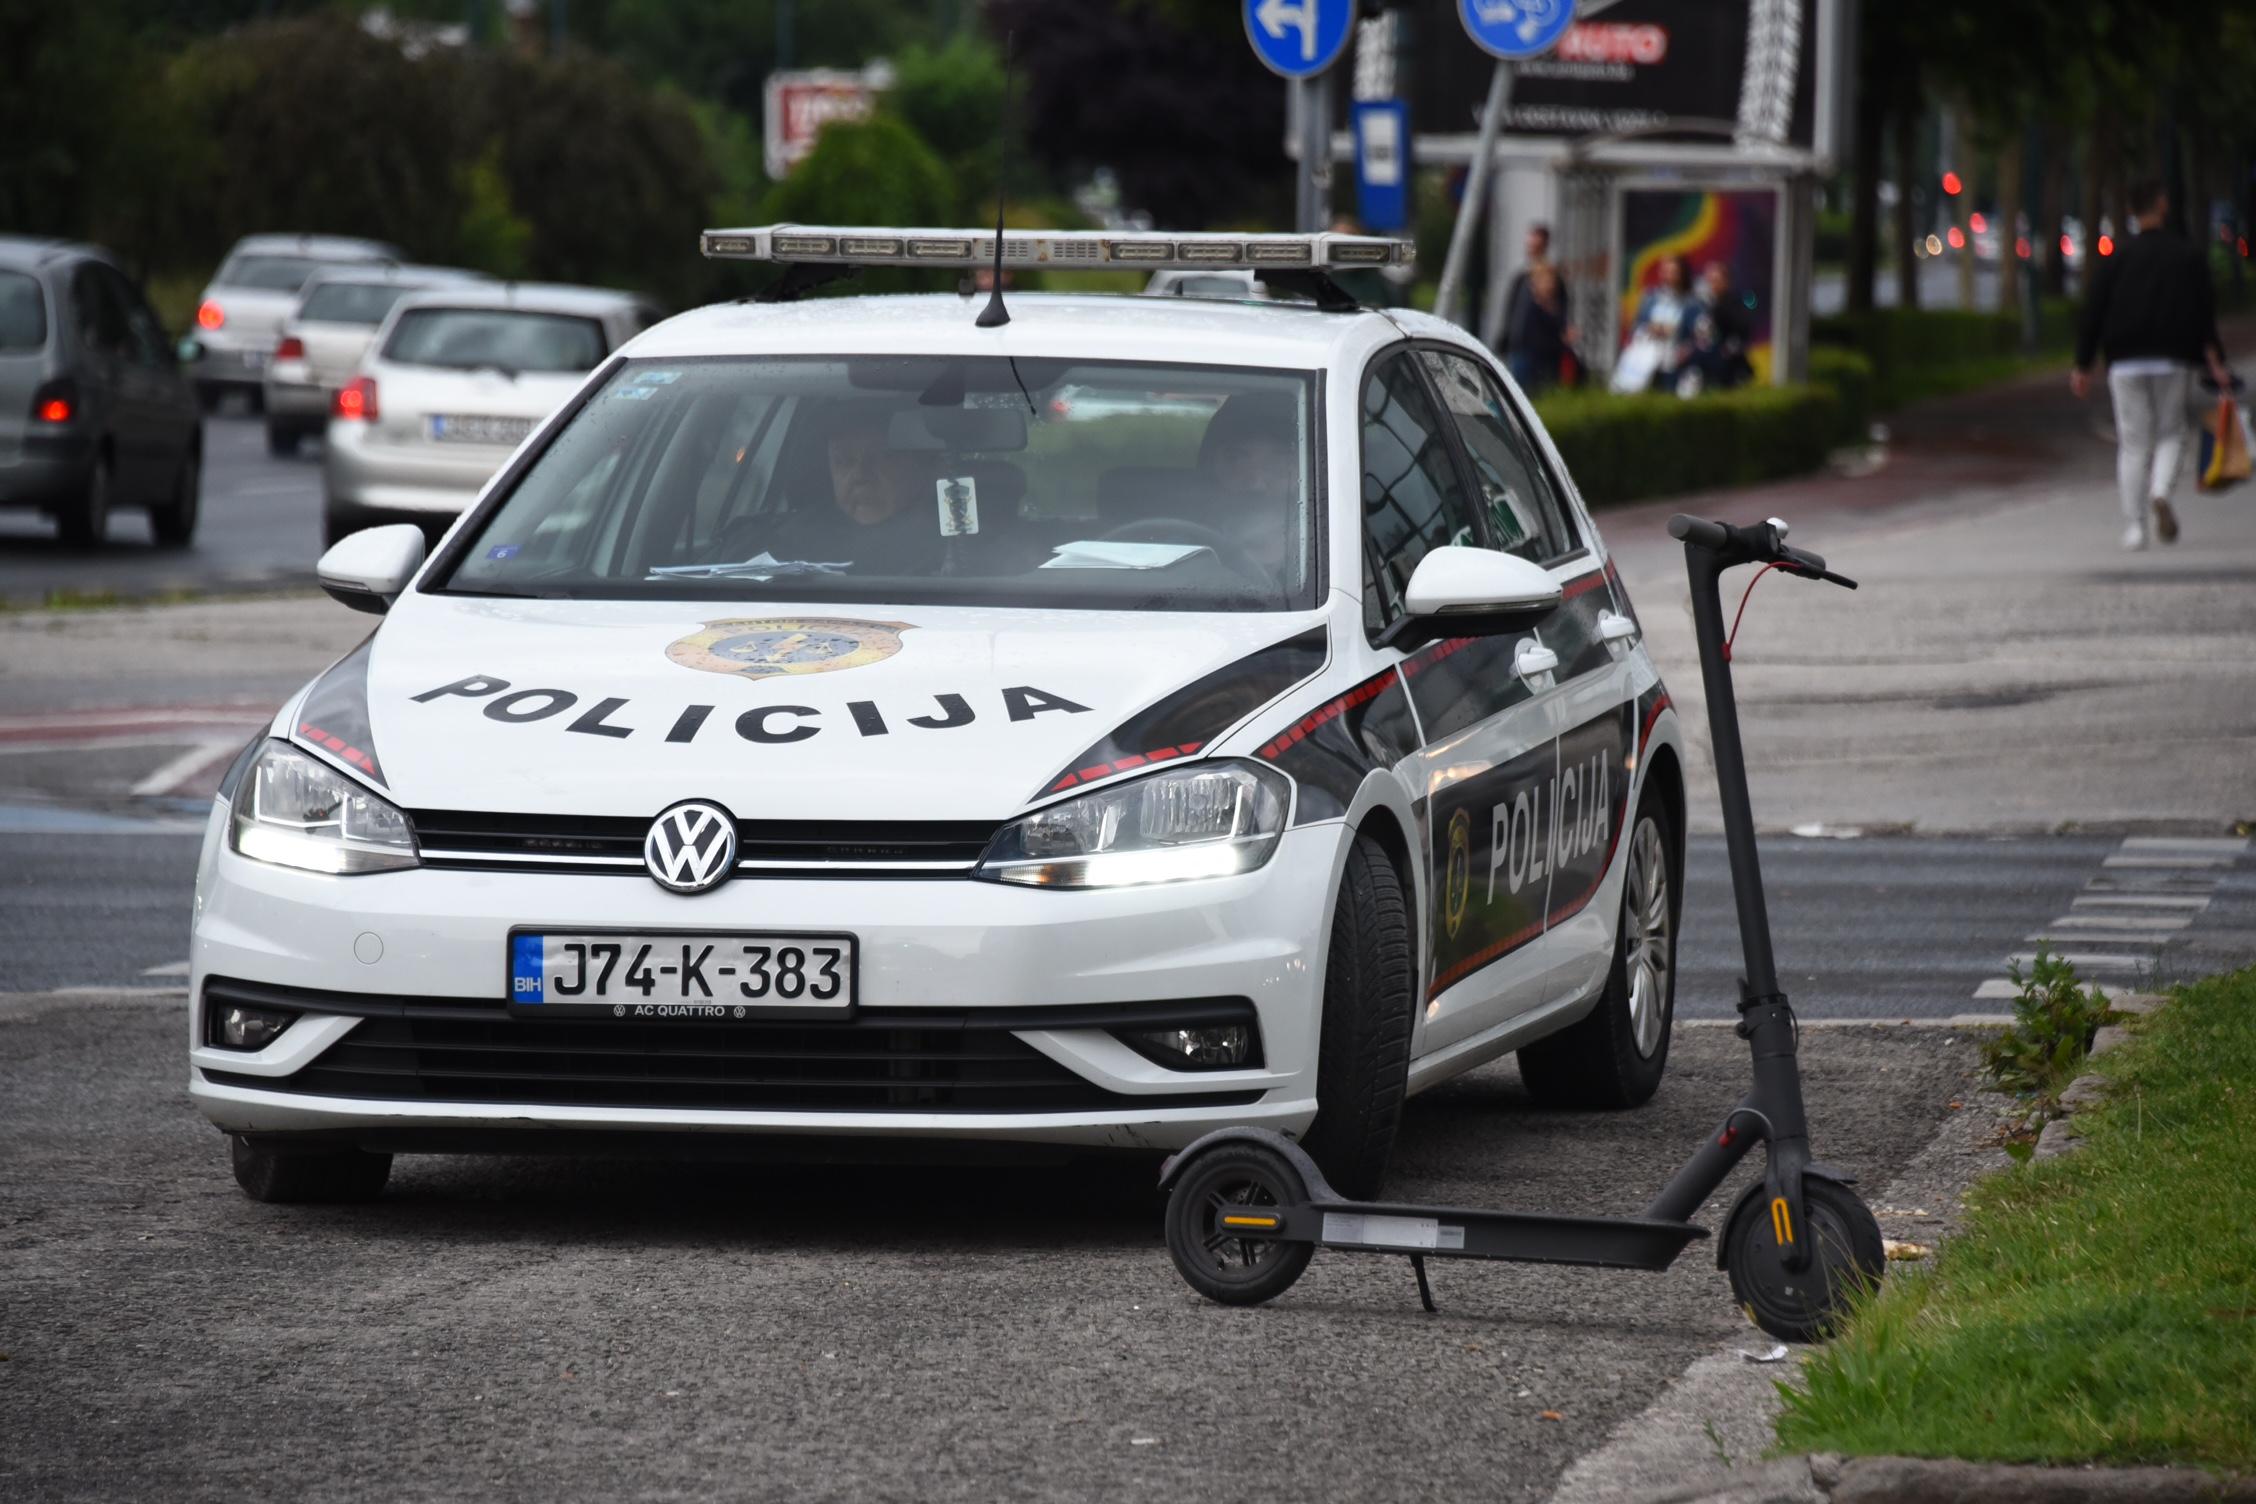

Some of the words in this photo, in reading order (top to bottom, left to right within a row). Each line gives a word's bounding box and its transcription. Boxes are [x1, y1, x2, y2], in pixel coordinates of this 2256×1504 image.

[409, 674, 1095, 744] POLICIJA
[1487, 749, 1609, 905] POLICIJA
[514, 976, 542, 993] BIH
[555, 944, 841, 999] J74-K-383
[634, 1004, 656, 1017] AC
[657, 1004, 725, 1018] QUATTRO
